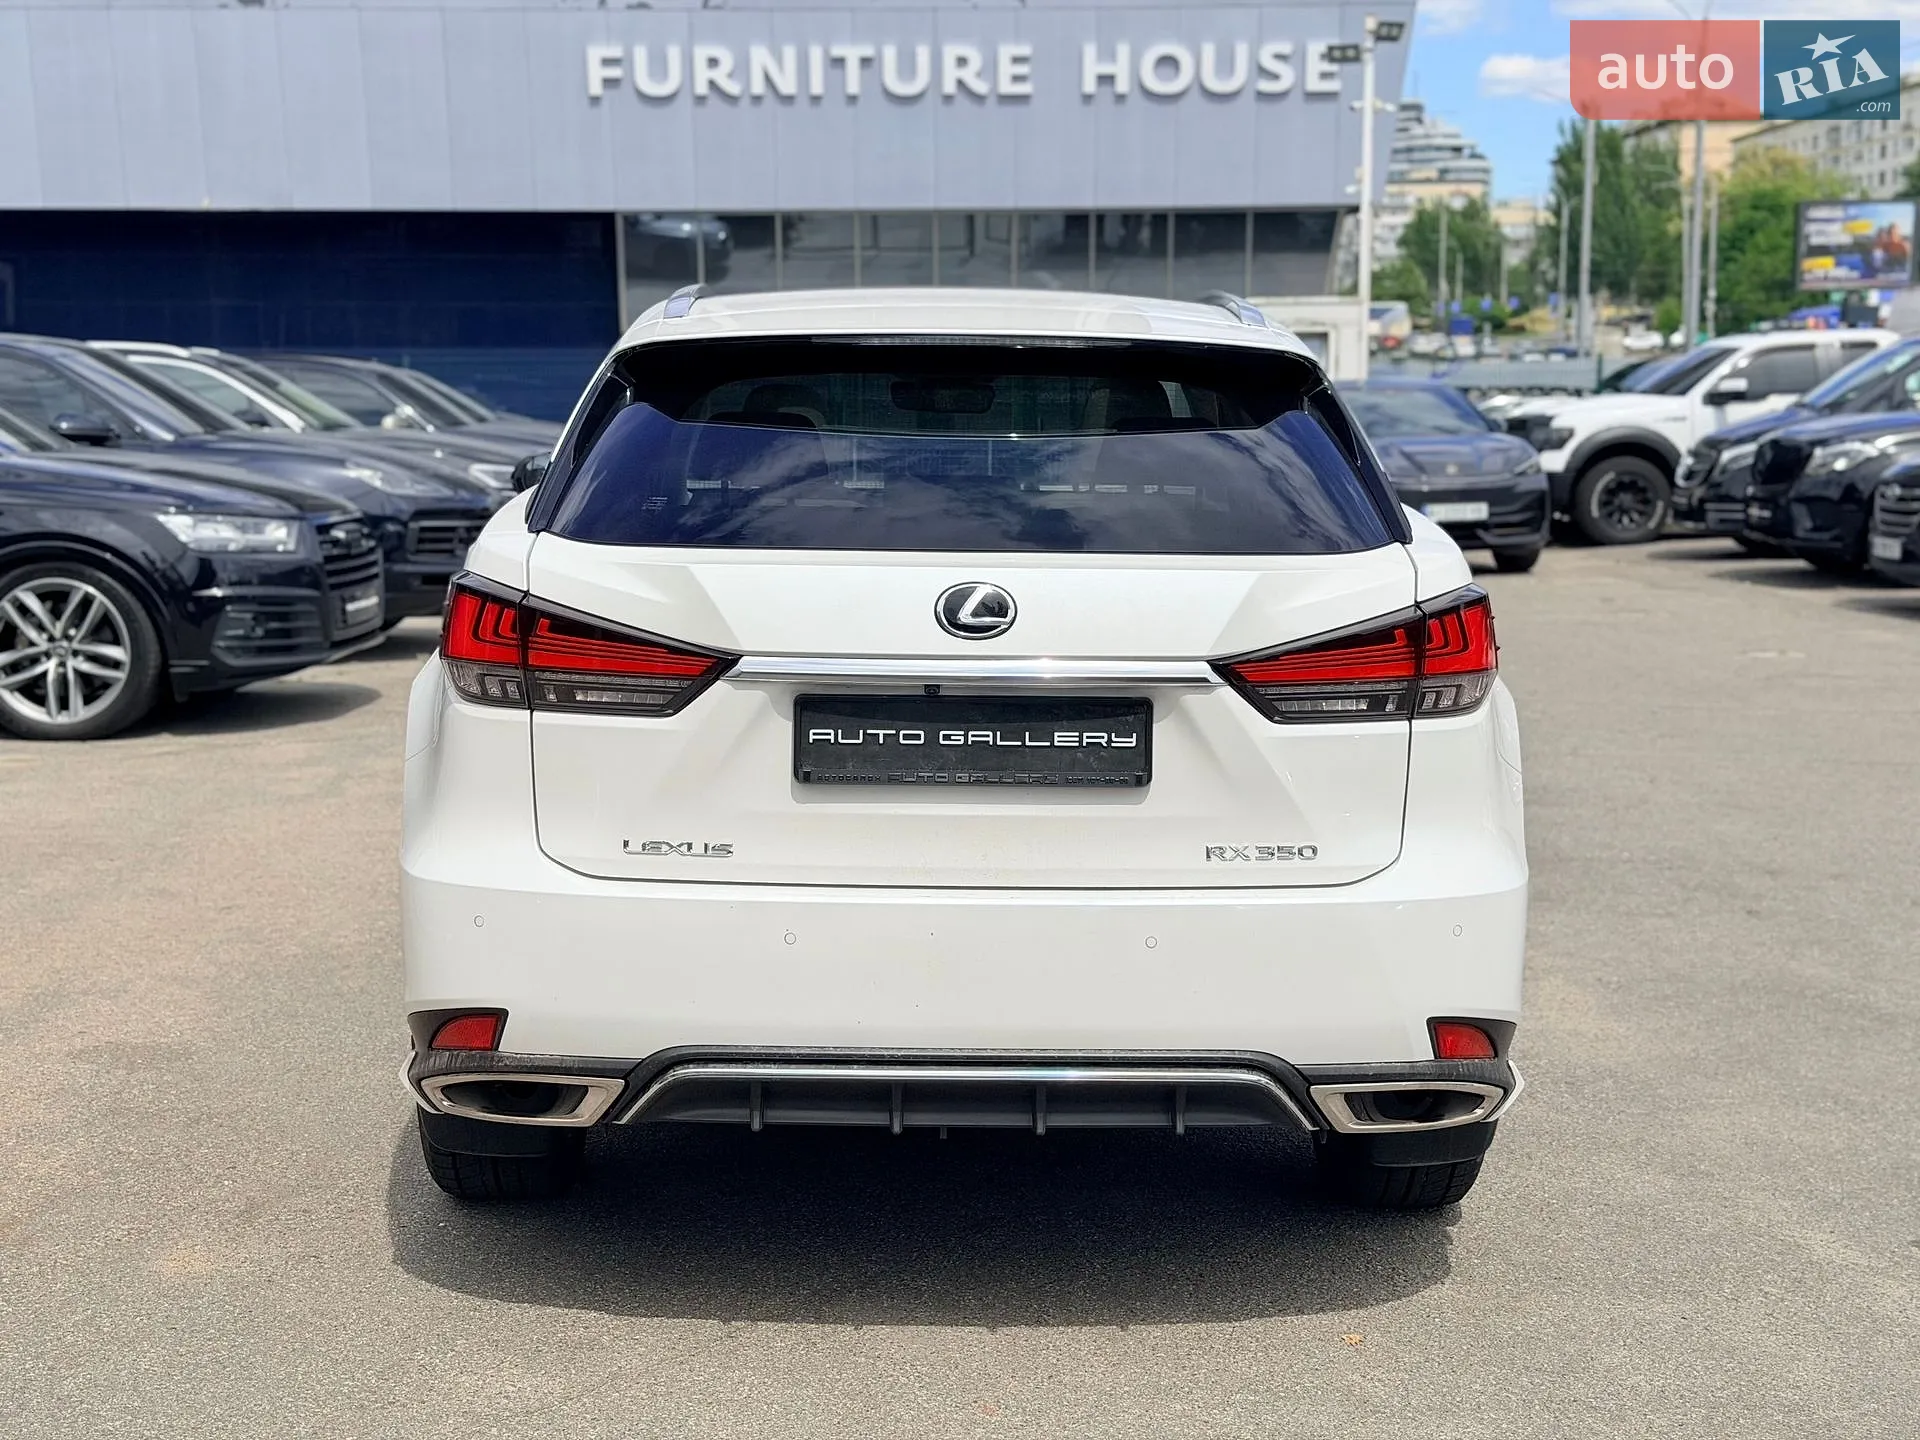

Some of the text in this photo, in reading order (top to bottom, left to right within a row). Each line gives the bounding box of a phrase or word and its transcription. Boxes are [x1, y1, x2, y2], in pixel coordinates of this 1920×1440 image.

[585, 41, 1343, 99] FURNITURE HOUSE
[808, 728, 1138, 748] AUTO GALLERY
[622, 839, 734, 858] LEXUS
